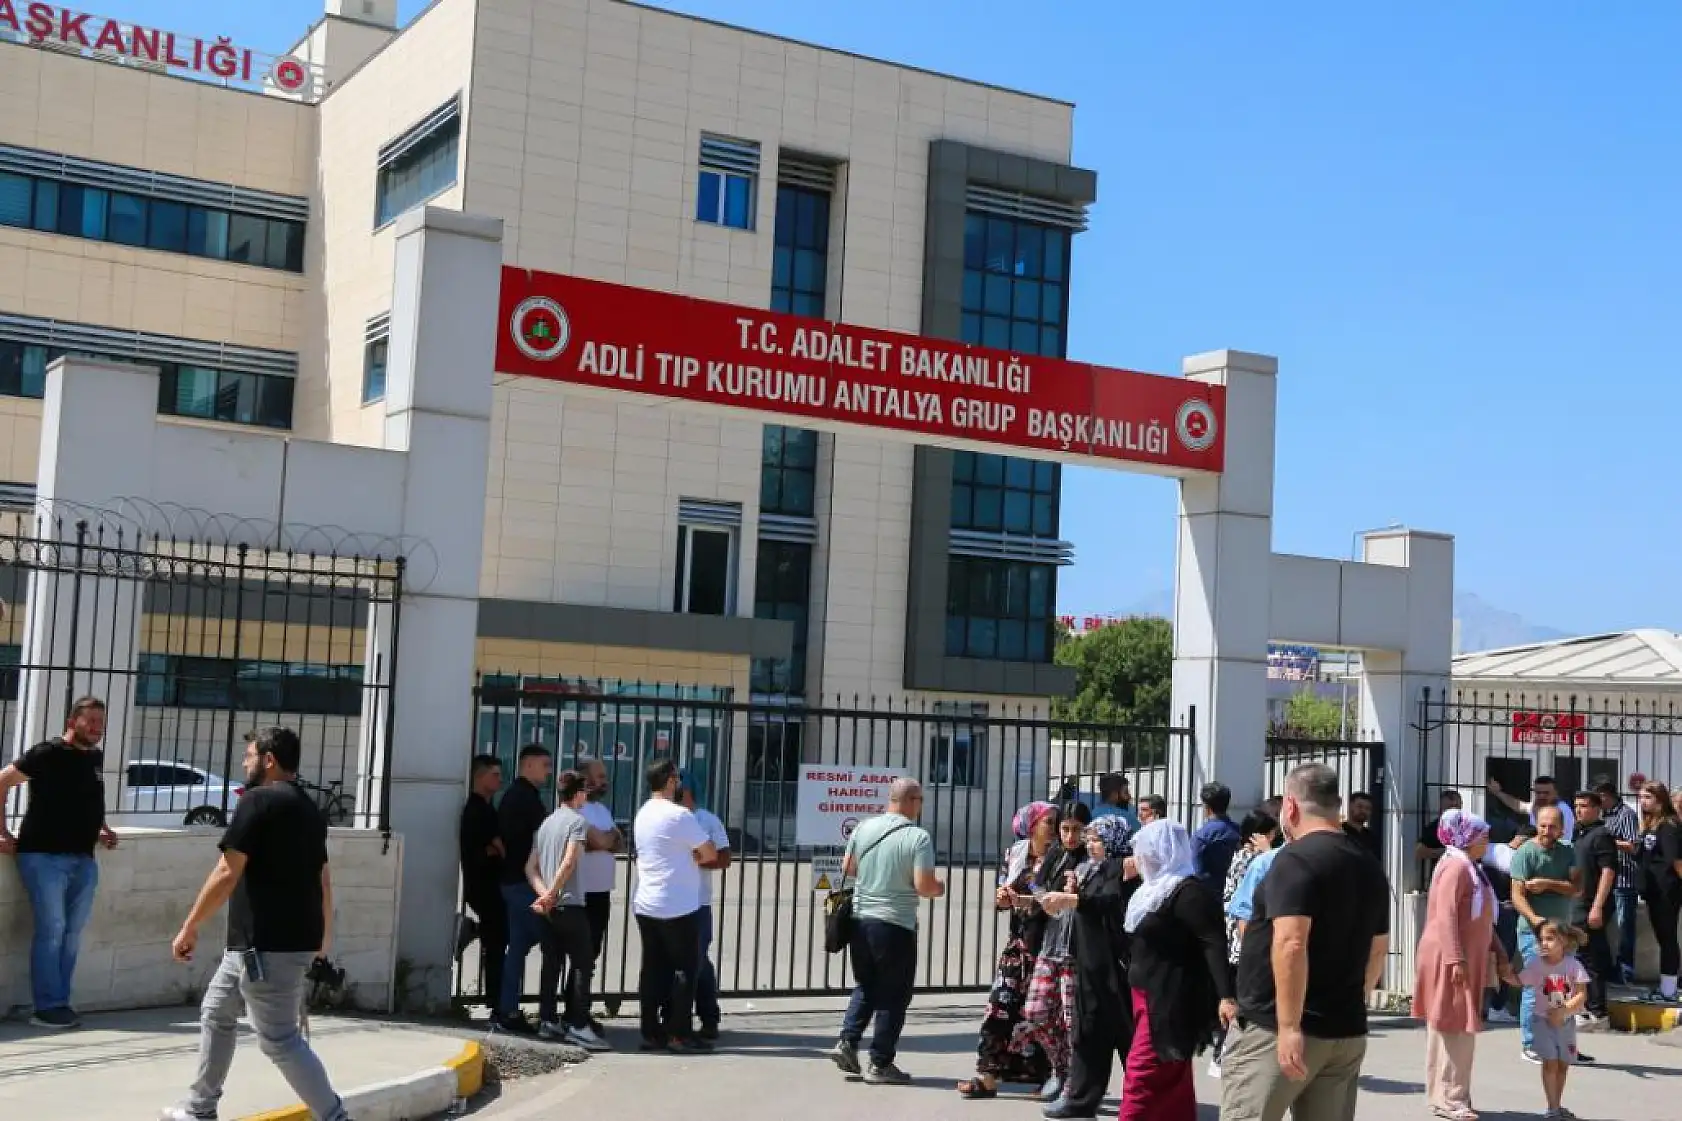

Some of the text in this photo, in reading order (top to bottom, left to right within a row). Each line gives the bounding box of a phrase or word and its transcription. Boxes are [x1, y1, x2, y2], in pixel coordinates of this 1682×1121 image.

[578, 340, 644, 382] ADLİ
[655, 352, 700, 388] TIP
[706, 361, 826, 407] KURUMU
[833, 380, 943, 423] ANTALYA
[951, 397, 1016, 432] GRUP
[1027, 408, 1169, 455] BAŞKANLIĞI
[736, 317, 1031, 394] T.C. ADALET BAKANLIĞI
